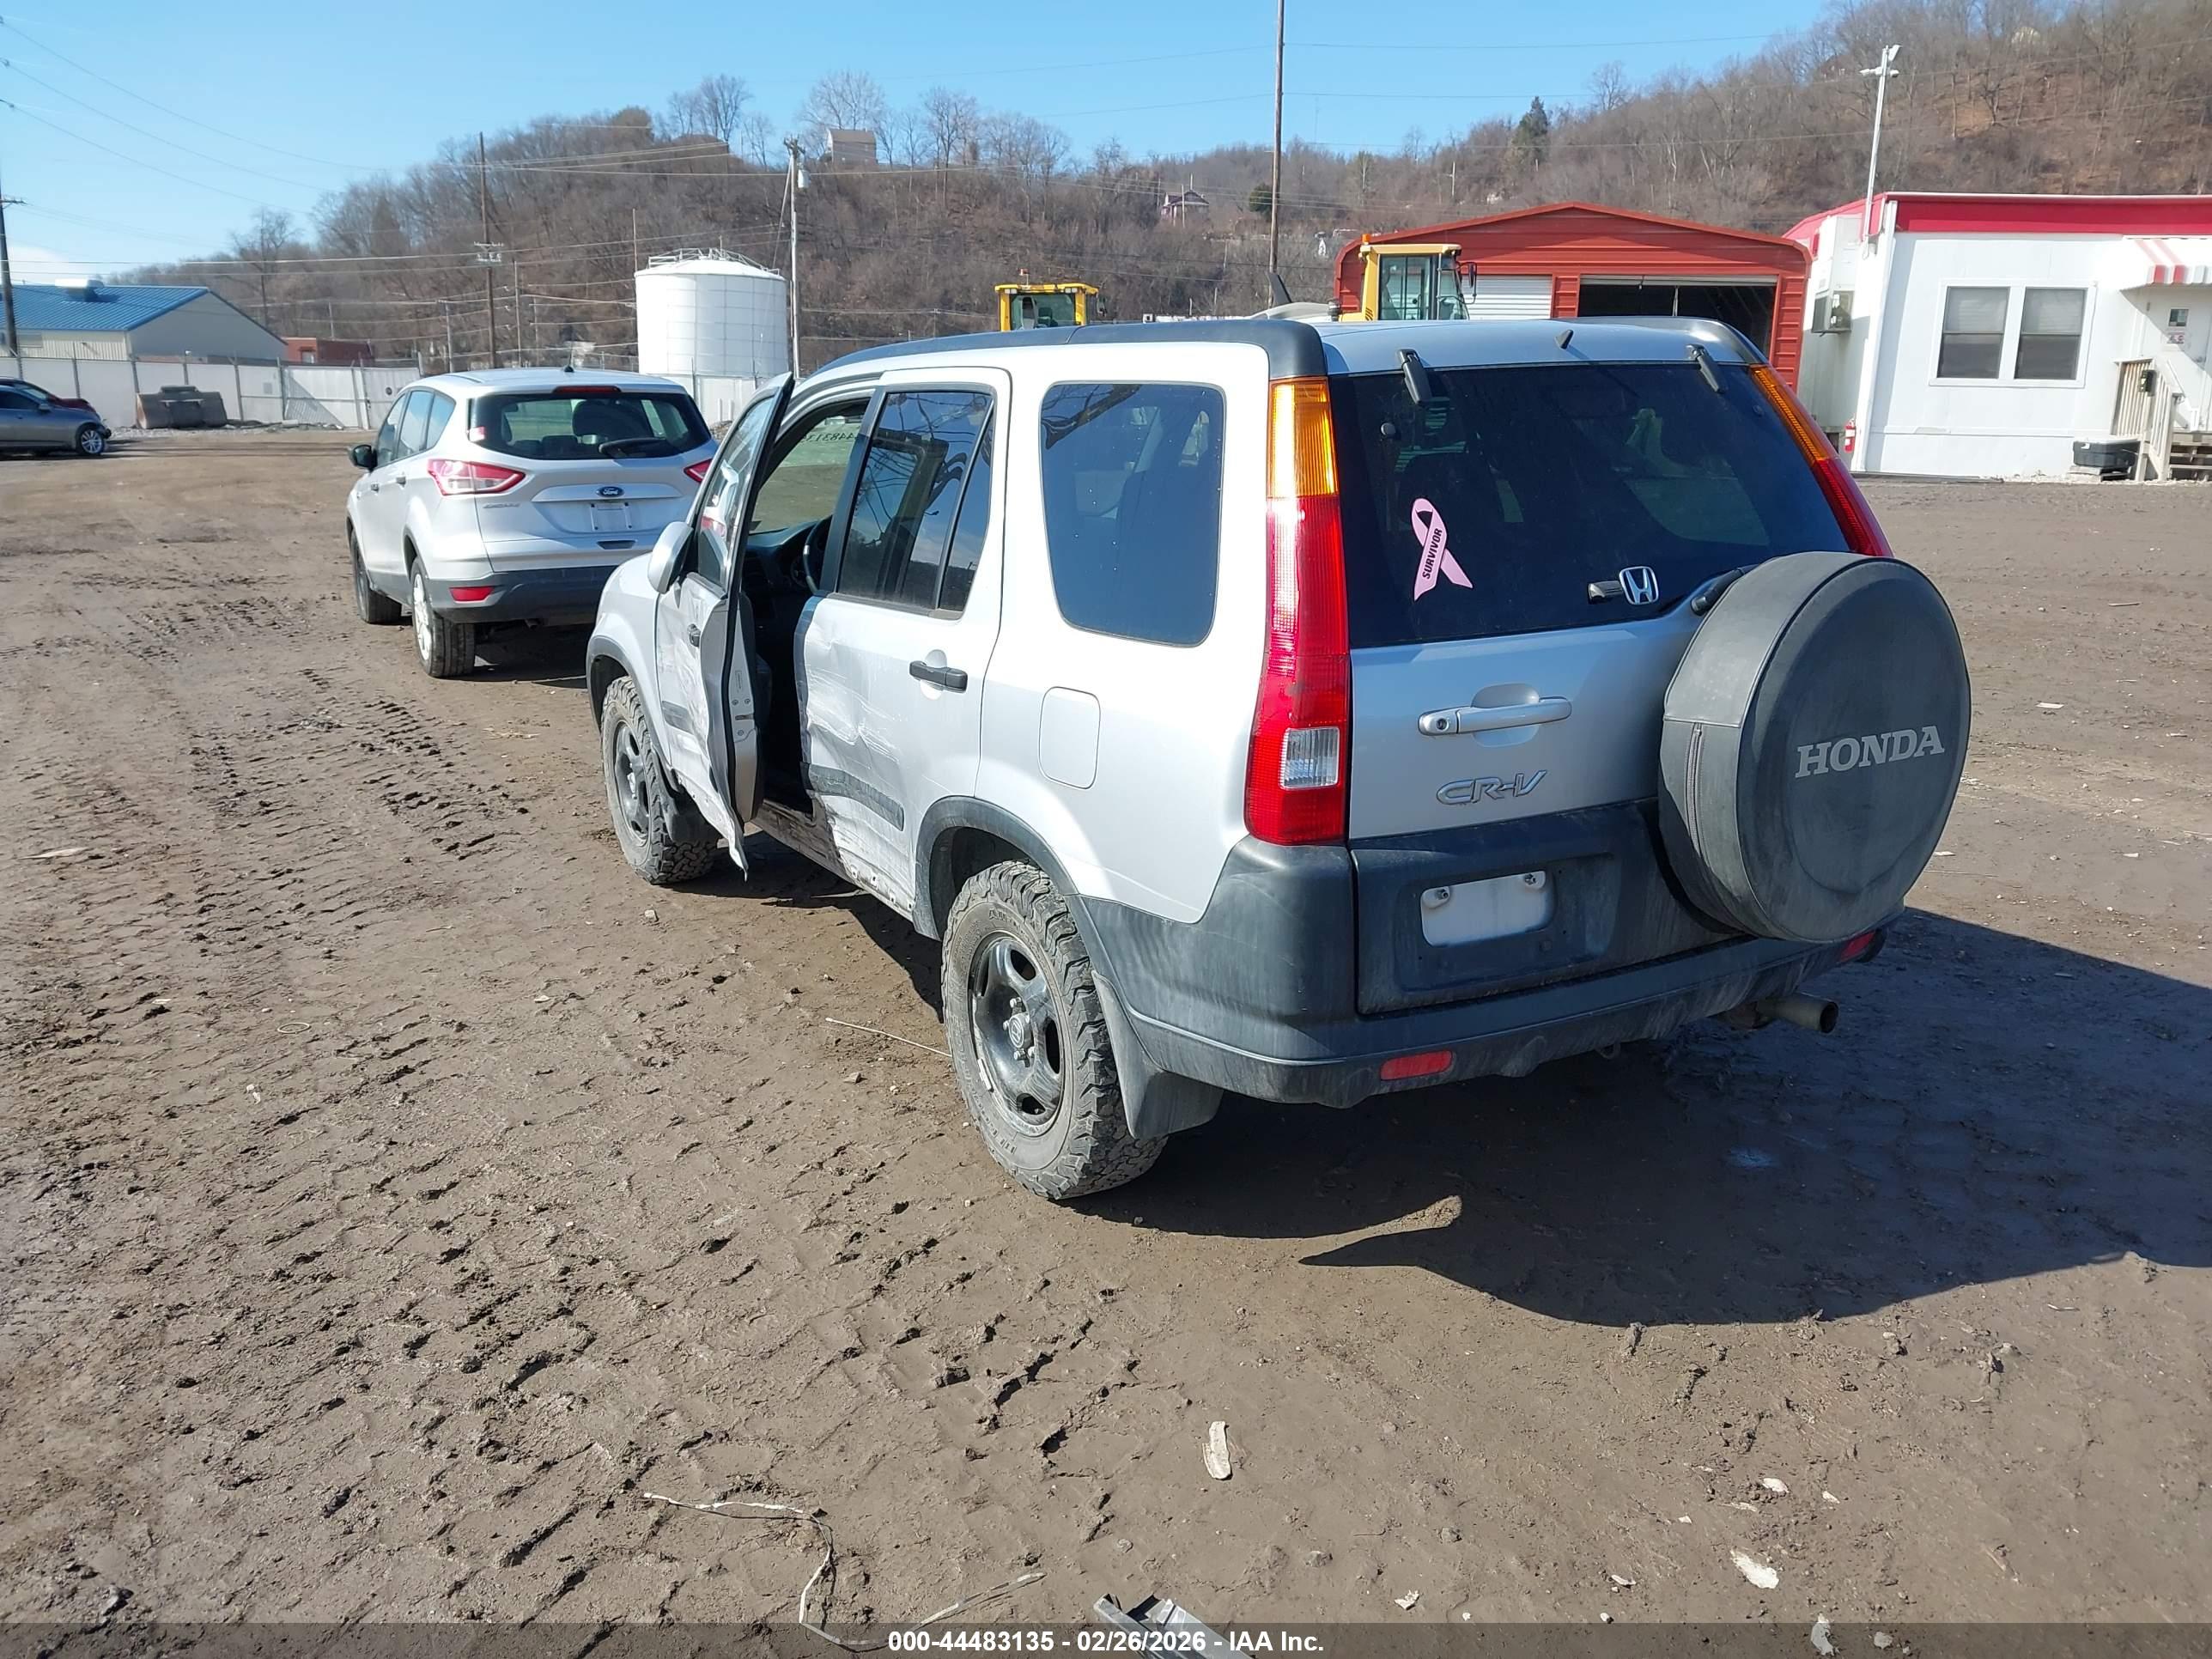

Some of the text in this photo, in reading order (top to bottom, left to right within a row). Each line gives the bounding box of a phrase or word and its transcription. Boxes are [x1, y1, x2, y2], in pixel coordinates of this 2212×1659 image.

[1422, 528, 1443, 579] SURVIVOR
[1795, 726, 1945, 778] HONDA
[1436, 769, 1547, 805] CR-V
